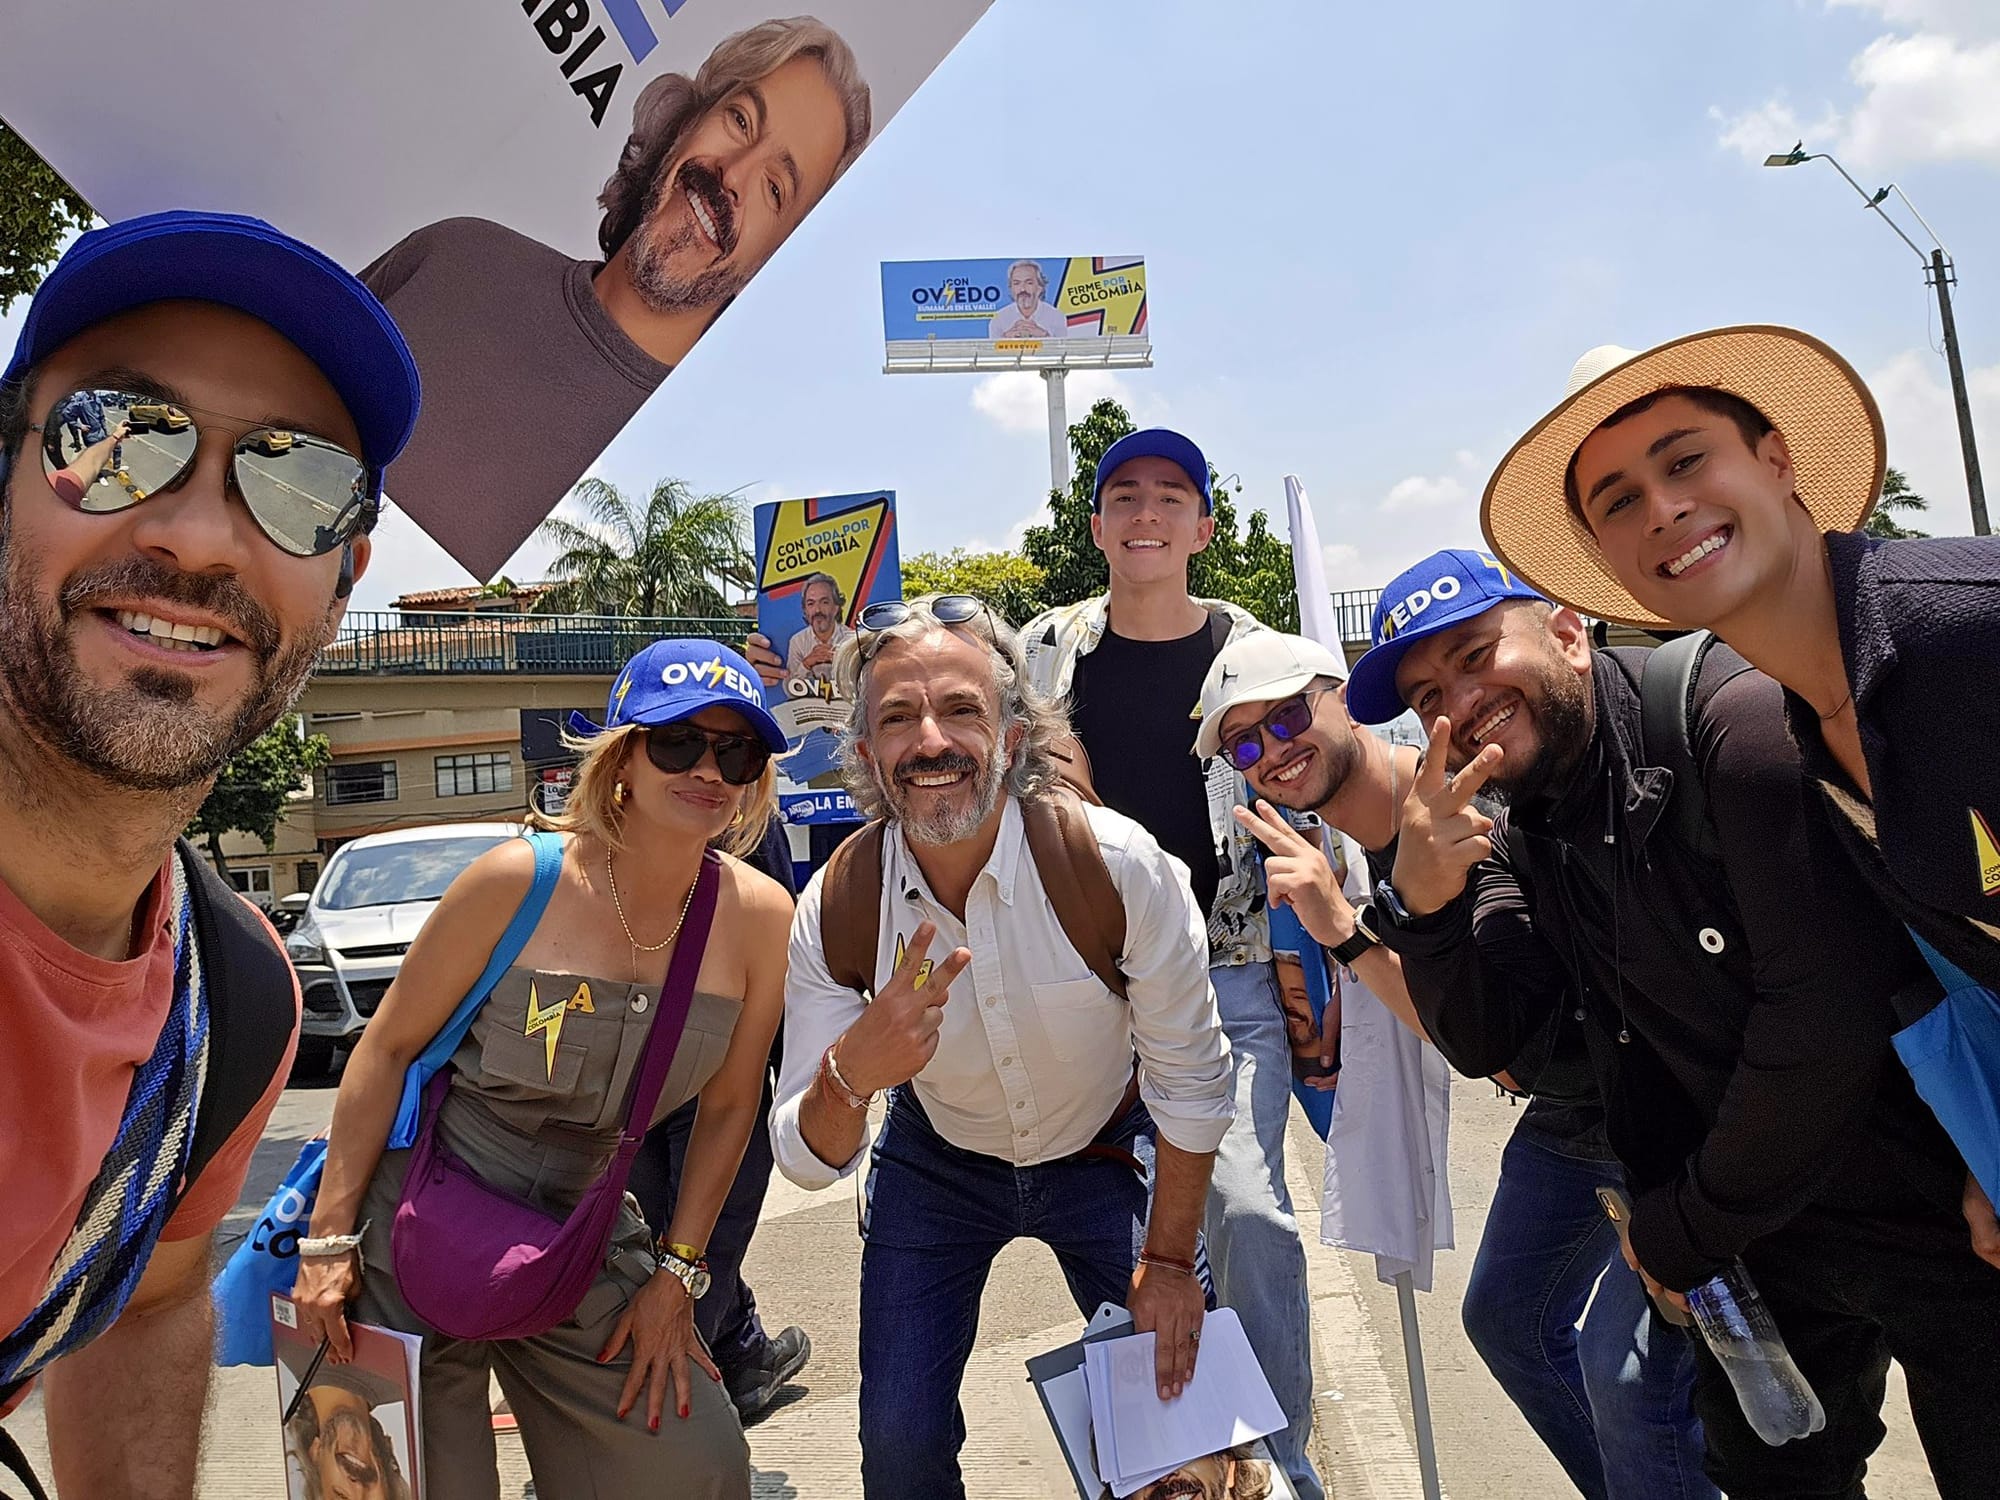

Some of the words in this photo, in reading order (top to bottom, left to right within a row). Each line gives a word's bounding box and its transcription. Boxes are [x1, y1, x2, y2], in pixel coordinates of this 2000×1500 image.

[521, 0, 624, 129] BIA
[1067, 281, 1102, 296] FIRME
[1103, 276, 1126, 287] POR
[1070, 280, 1144, 306] COLOMBIA
[775, 533, 861, 573] COLOMBIA
[777, 539, 805, 558] CON
[805, 528, 842, 548] TODA
[842, 518, 870, 536] POR
[815, 796, 832, 810] LA
[1985, 872, 2000, 884] CO
[567, 982, 596, 1014] A
[252, 1217, 304, 1258] CO
